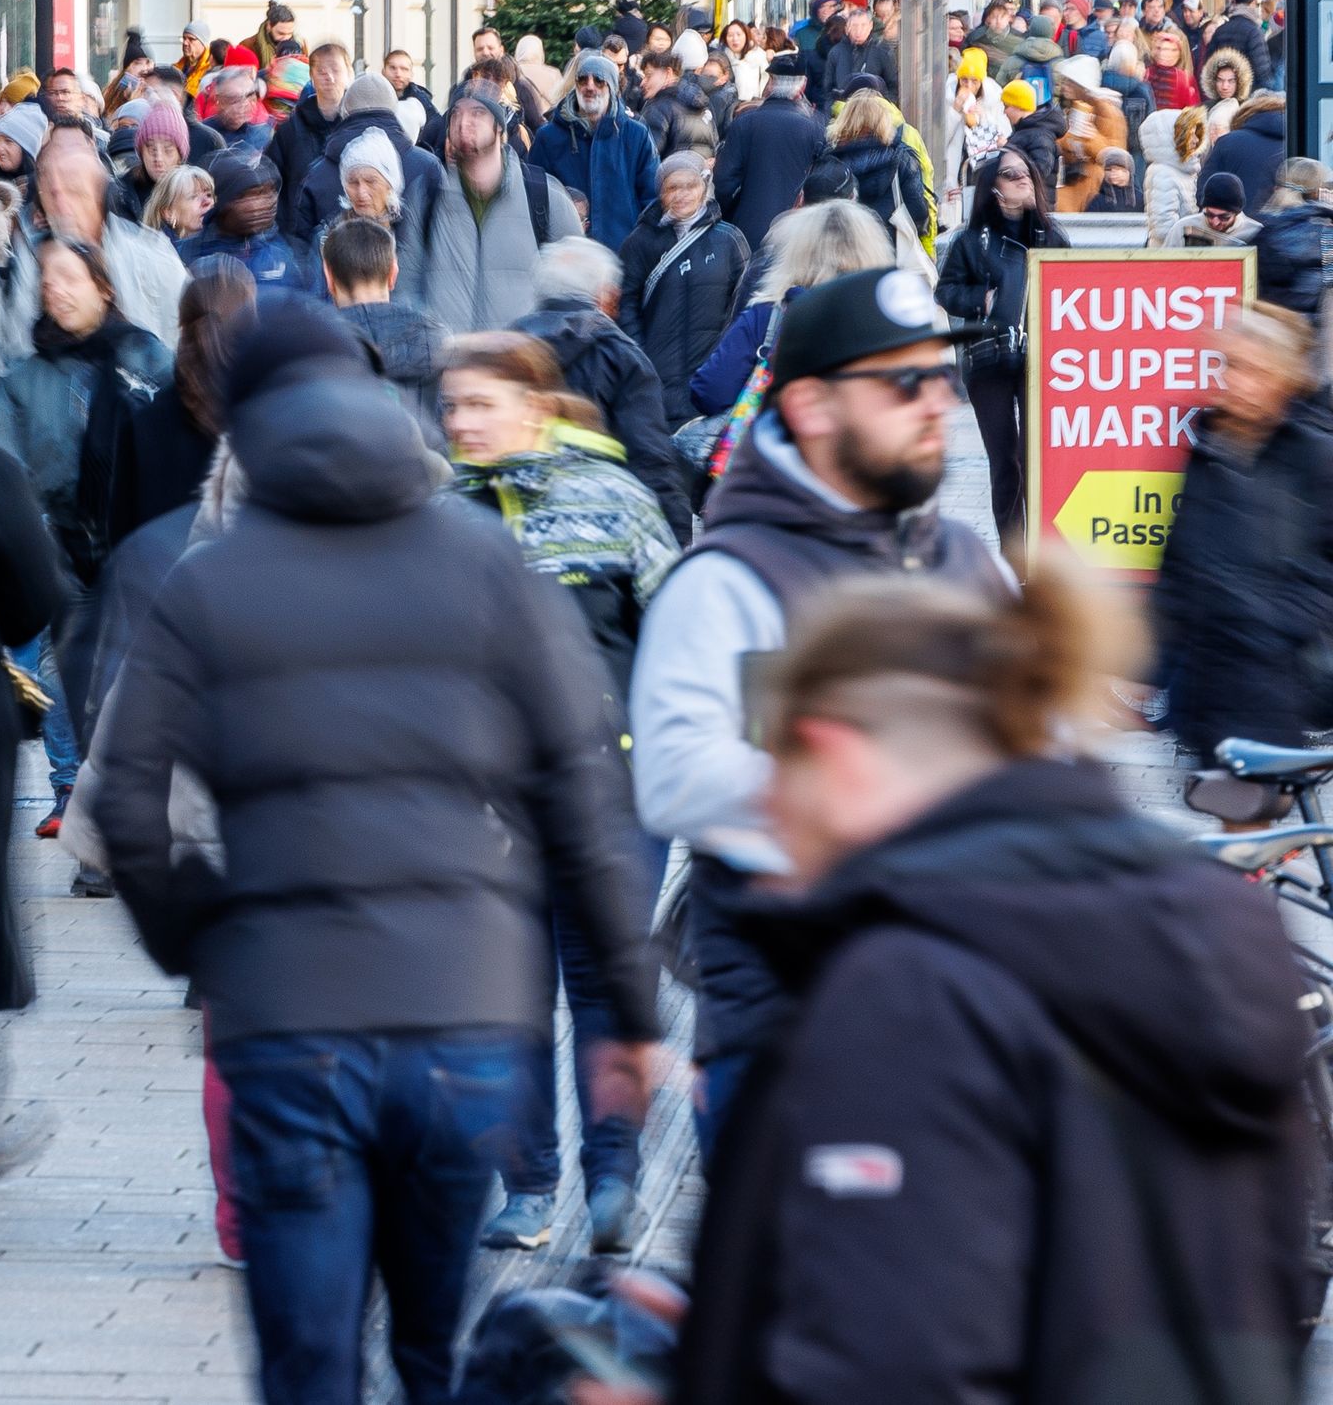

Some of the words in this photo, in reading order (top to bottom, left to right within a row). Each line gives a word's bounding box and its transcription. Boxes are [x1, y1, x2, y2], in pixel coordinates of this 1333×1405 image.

[1049, 286, 1237, 332] KUNST
[1047, 348, 1230, 392] SUPER
[1049, 405, 1205, 449] MARK
[1133, 485, 1162, 514] In
